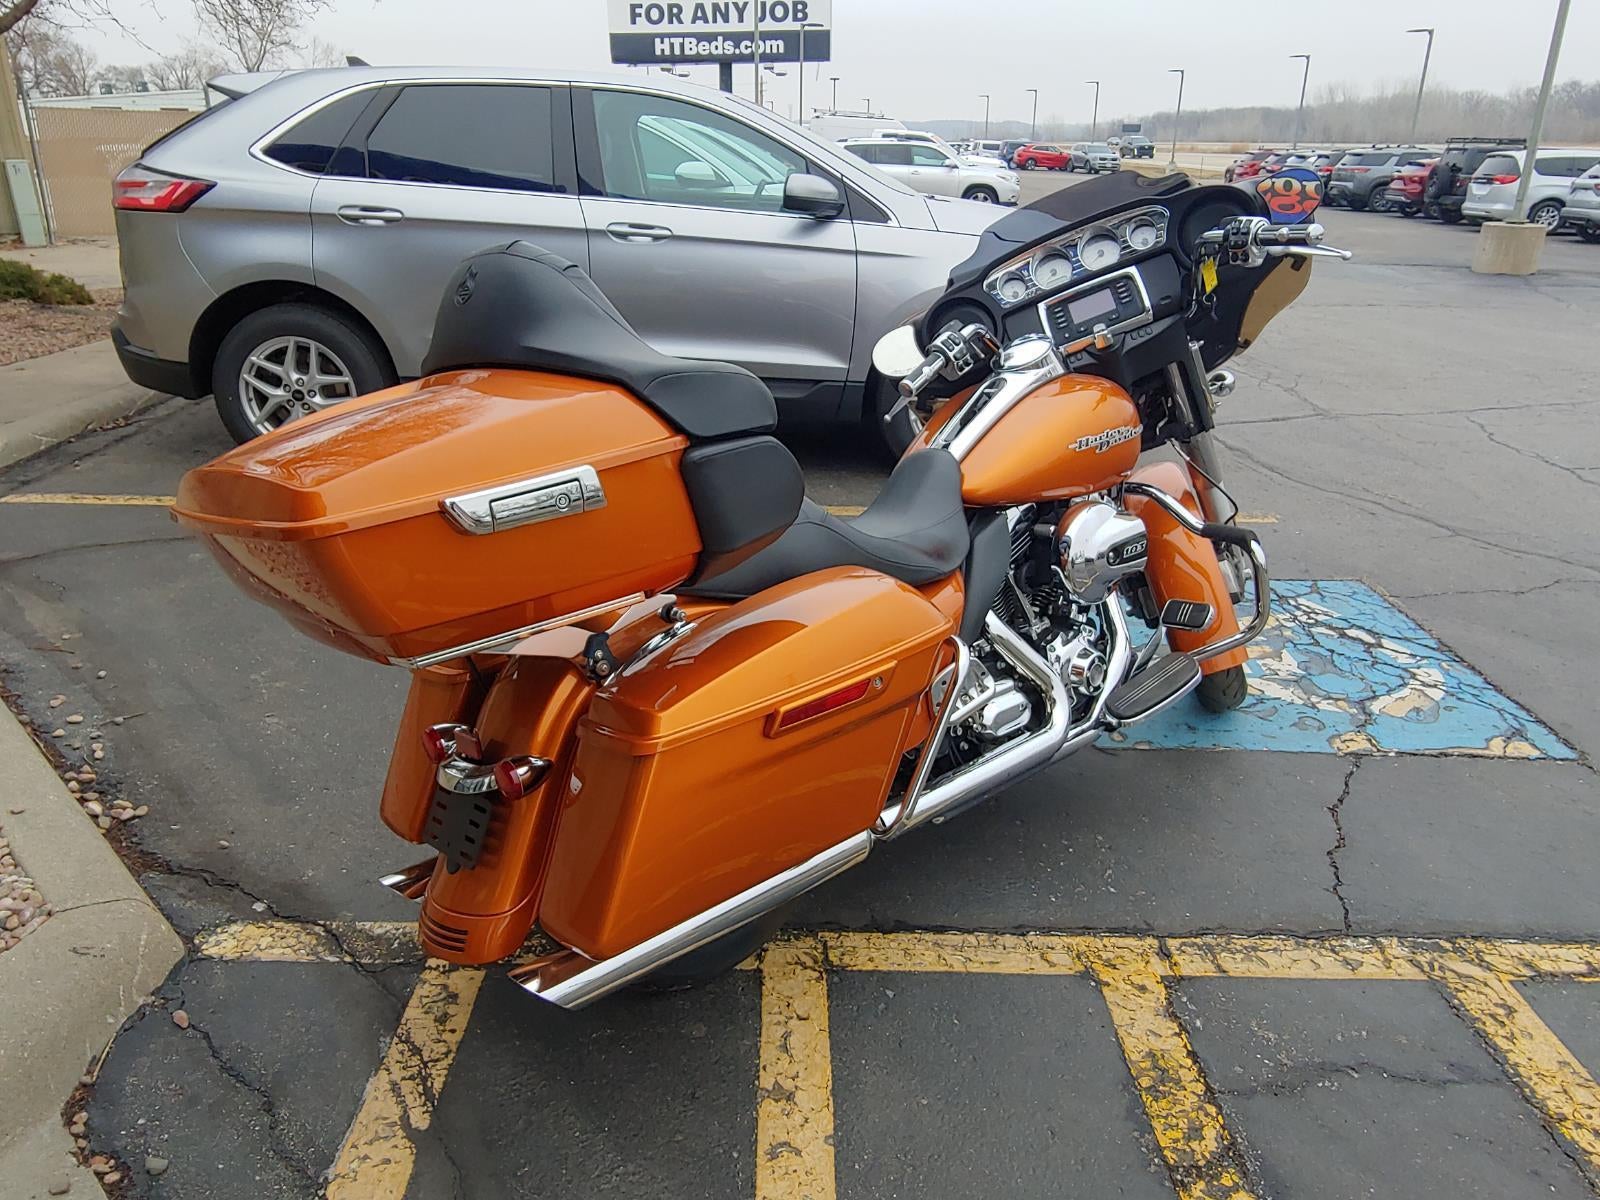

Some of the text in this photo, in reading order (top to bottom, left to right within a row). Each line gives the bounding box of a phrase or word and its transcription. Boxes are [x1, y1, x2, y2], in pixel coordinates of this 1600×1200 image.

[630, 0, 809, 25] FOR ANY JOB
[654, 36, 784, 56] HTBeds.com
[1123, 540, 1147, 558] 103
